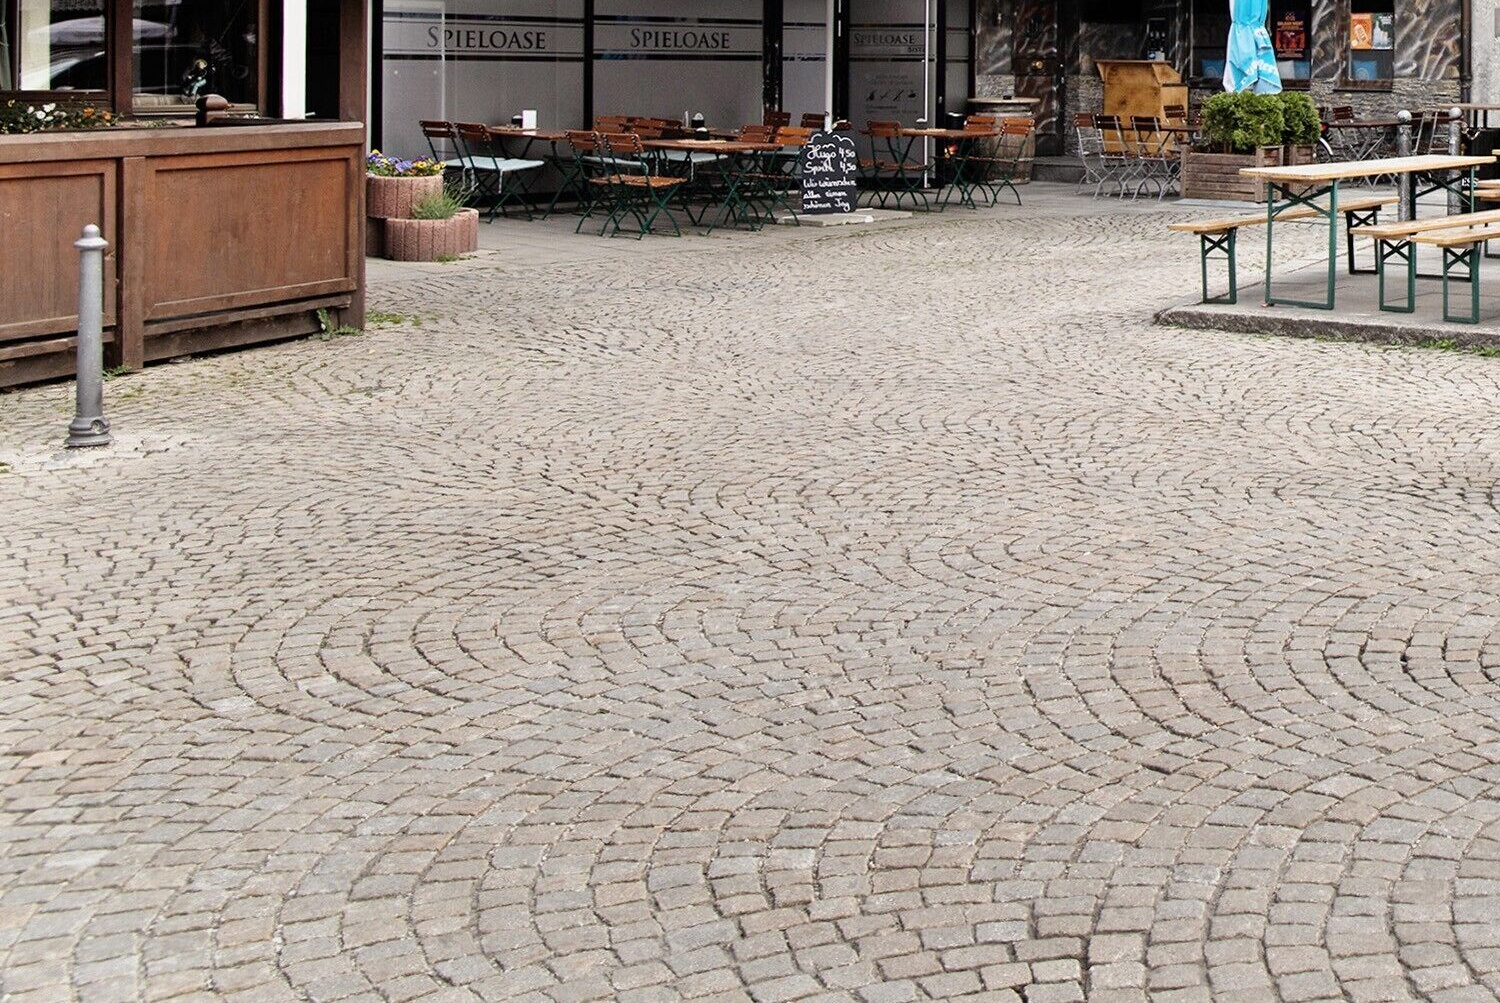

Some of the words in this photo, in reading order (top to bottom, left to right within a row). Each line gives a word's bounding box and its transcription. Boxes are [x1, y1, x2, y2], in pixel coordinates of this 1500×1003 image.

[427, 26, 547, 50] SPIELOASE
[630, 27, 731, 49] SPIELOASE
[853, 32, 916, 45] SPIELOASE
[806, 144, 837, 163] Hugo
[834, 197, 851, 213] Tag
